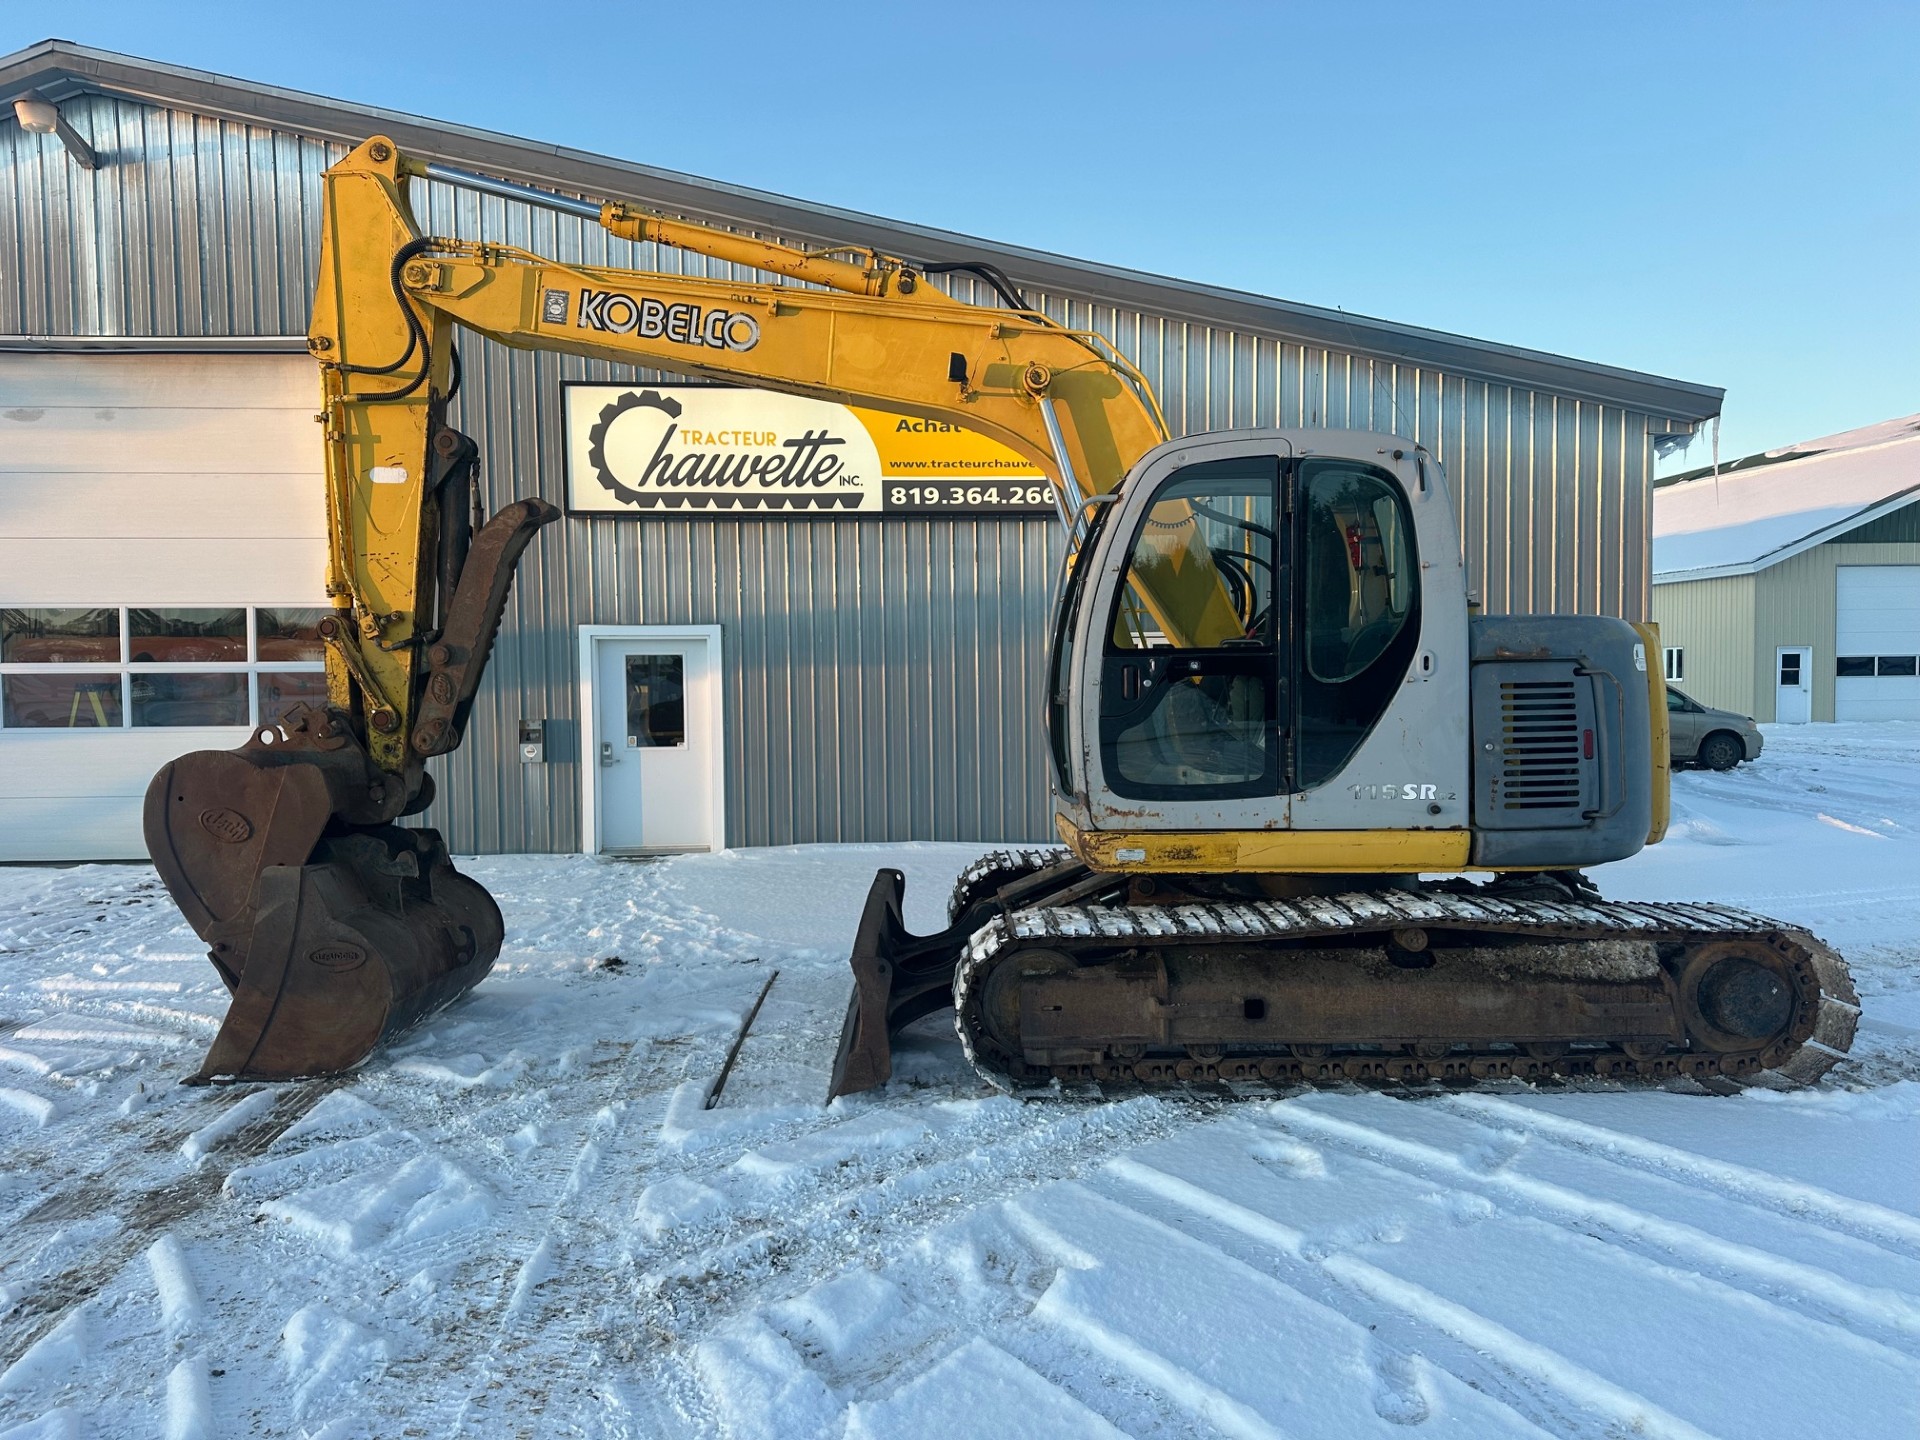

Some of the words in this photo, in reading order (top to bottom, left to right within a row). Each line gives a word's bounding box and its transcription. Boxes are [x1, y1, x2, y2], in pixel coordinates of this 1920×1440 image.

[577, 288, 761, 352] KOBELCO
[589, 389, 864, 508] Chauvette
[839, 475, 864, 487] INC.
[680, 430, 777, 446] TRACTEUR
